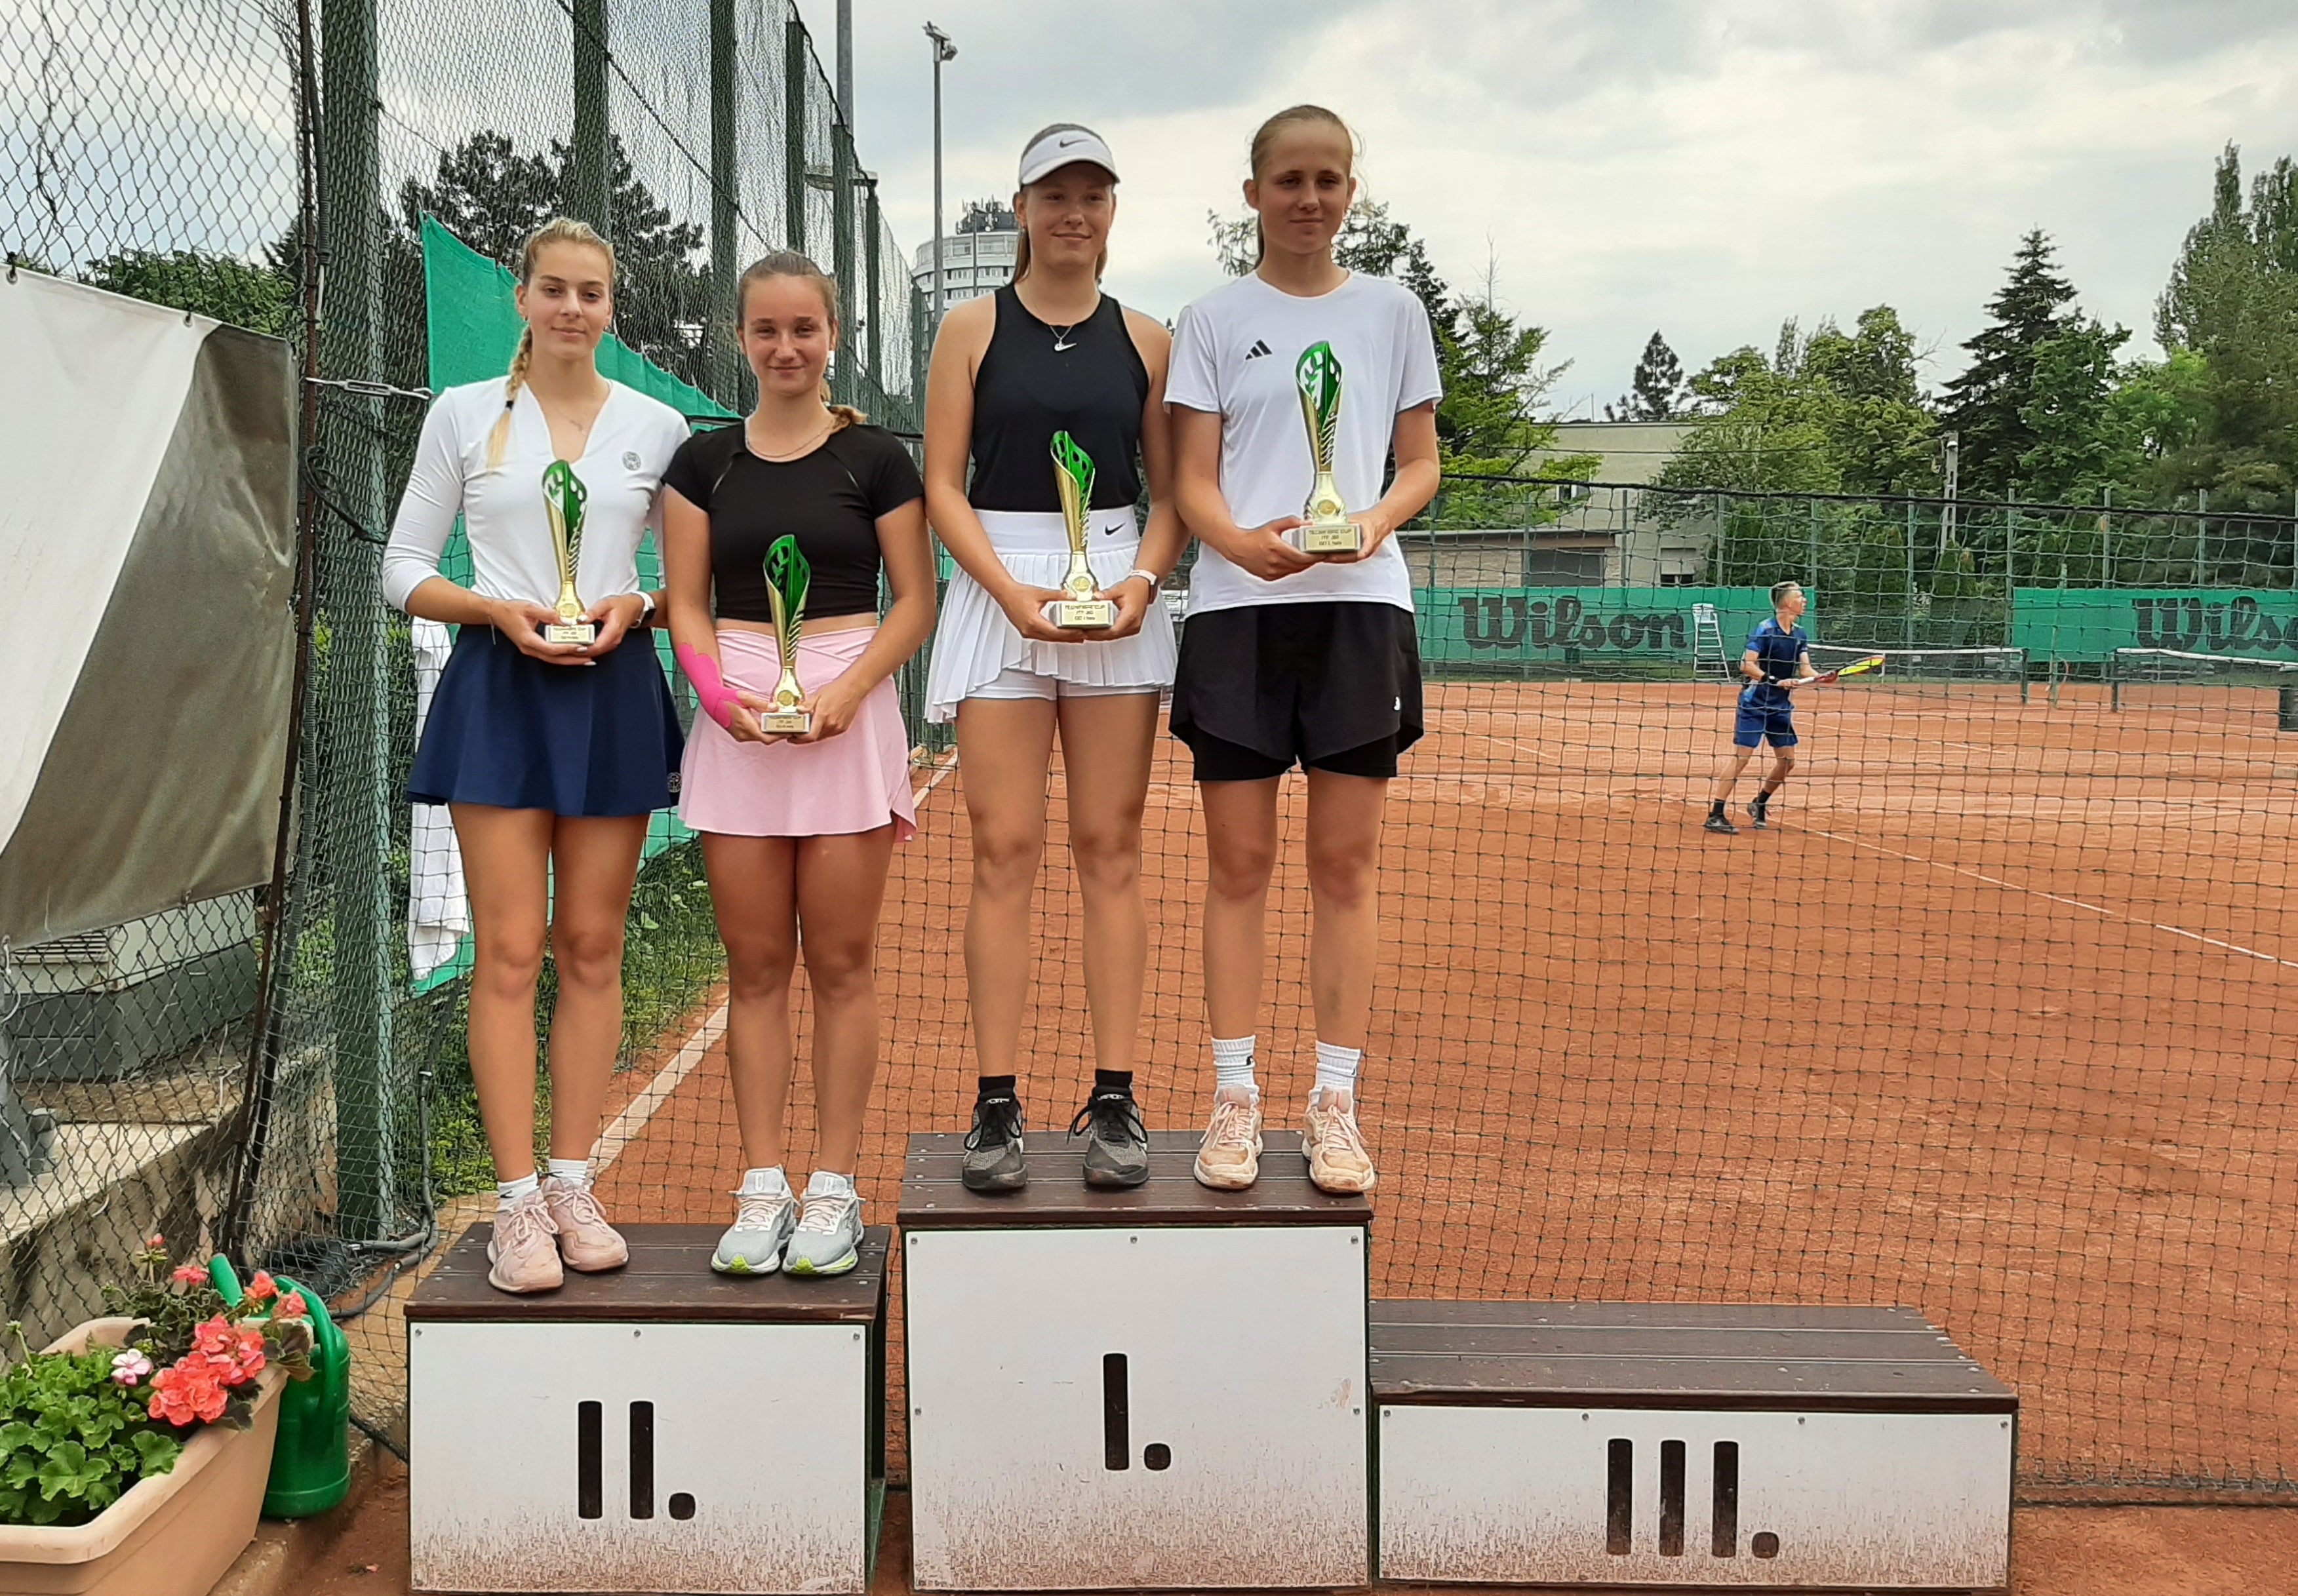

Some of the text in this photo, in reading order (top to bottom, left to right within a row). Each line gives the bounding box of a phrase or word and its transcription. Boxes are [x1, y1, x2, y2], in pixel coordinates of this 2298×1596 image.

[1459, 595, 1688, 650] Wilson
[578, 1401, 696, 1519] II.
[1103, 1353, 1171, 1471] I.
[1606, 1438, 1779, 1558] III.
